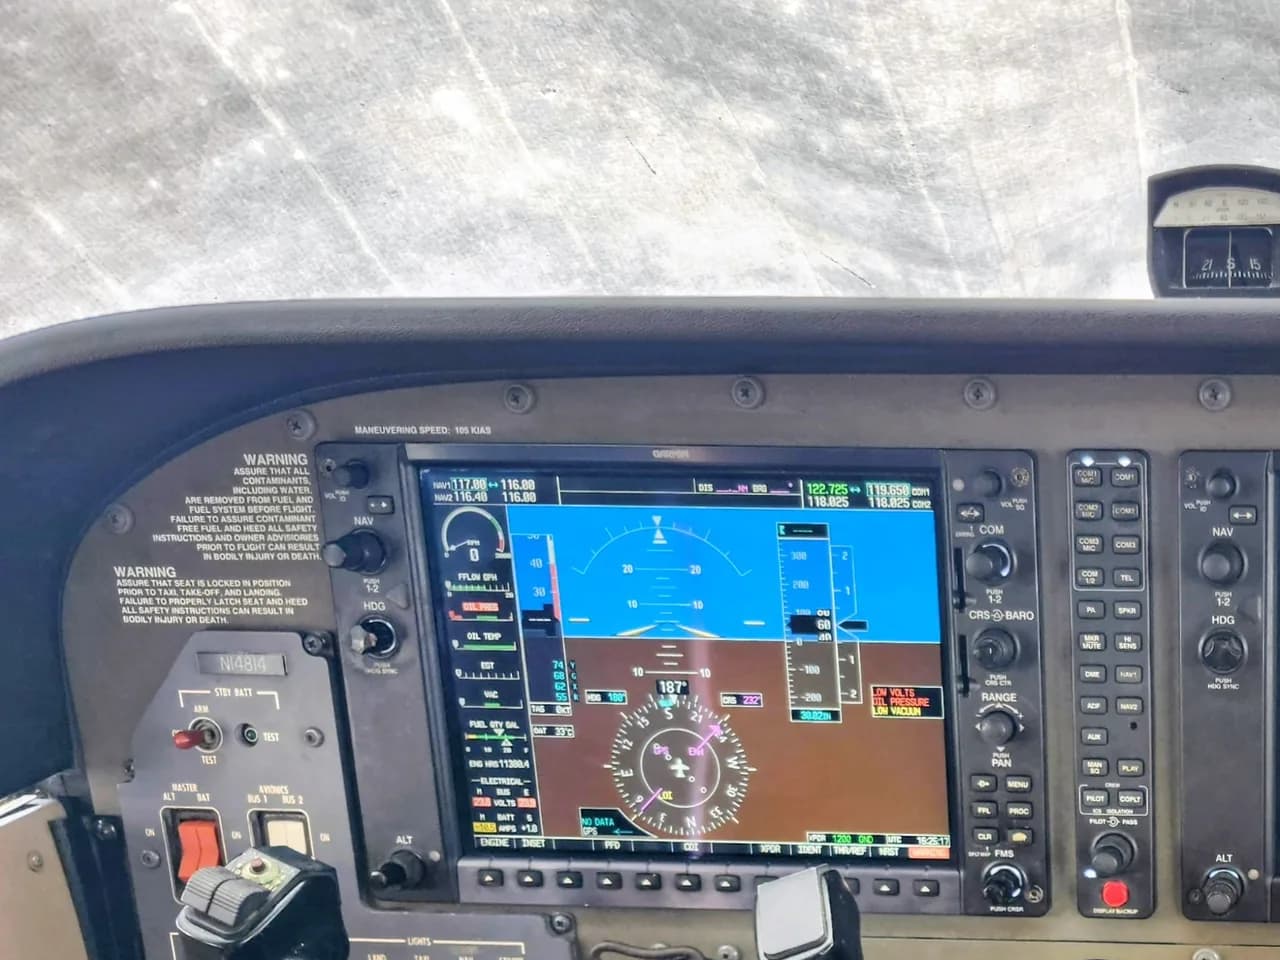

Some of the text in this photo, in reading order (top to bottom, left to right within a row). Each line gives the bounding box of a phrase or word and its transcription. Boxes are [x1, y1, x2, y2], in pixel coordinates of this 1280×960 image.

[1202, 259, 1213, 271] 21
[1250, 258, 1261, 271] 15
[355, 426, 491, 435] MANEUVERING SPEED: 105 KIAS
[244, 453, 308, 466] WARNING
[453, 479, 487, 490] 117.00
[501, 479, 536, 490] 116.00
[807, 484, 848, 495] 122.725
[869, 484, 910, 496] 119.650
[454, 492, 488, 502] 116.40
[502, 492, 536, 503] 116.00
[808, 496, 849, 508] 118.025
[869, 497, 910, 509] 118.025
[171, 515, 316, 523] FAILURE TO ASSURE CONTAMINANT
[354, 517, 374, 526] NAV
[979, 525, 1005, 535] COM
[1212, 528, 1234, 537] NAV
[152, 534, 213, 542] INSTRUCTIONS
[215, 534, 233, 542] AND
[234, 534, 265, 542] OWNER
[113, 566, 177, 578] WARNING
[622, 564, 633, 573] 20
[690, 566, 701, 574] 20
[116, 579, 150, 587] ASSURE
[151, 579, 173, 587] THAT
[175, 579, 195, 587] SEAT
[366, 585, 379, 593] 1-2
[628, 600, 638, 608] 10
[988, 595, 1002, 604] 1-2
[1217, 598, 1231, 606] 1-2
[363, 602, 386, 611] HDG
[693, 601, 703, 609] 10
[969, 611, 991, 620] CRS
[1005, 611, 1035, 621] BARO
[1212, 616, 1235, 625] HDG
[220, 655, 266, 672] N14814
[552, 660, 563, 669] 74
[553, 671, 564, 680] 68
[632, 668, 644, 677] 10
[699, 668, 711, 678] 10
[555, 682, 566, 691] 62
[660, 680, 687, 694] 187°
[555, 693, 567, 702] 55
[890, 689, 915, 697] VOLTS
[890, 698, 930, 707] PRESSURE
[981, 693, 1017, 703] RANGE
[891, 707, 921, 716] VACUUM
[263, 733, 280, 742] TEST
[201, 756, 217, 765] TEST
[992, 758, 1012, 768] PAN
[1122, 765, 1139, 773] PLAY
[1007, 780, 1029, 788] MENU
[1009, 806, 1029, 816] PROC
[594, 818, 615, 827] DATA
[978, 832, 992, 841] CLR
[994, 850, 1014, 858] FMS
[407, 938, 431, 946] LIGHTS
